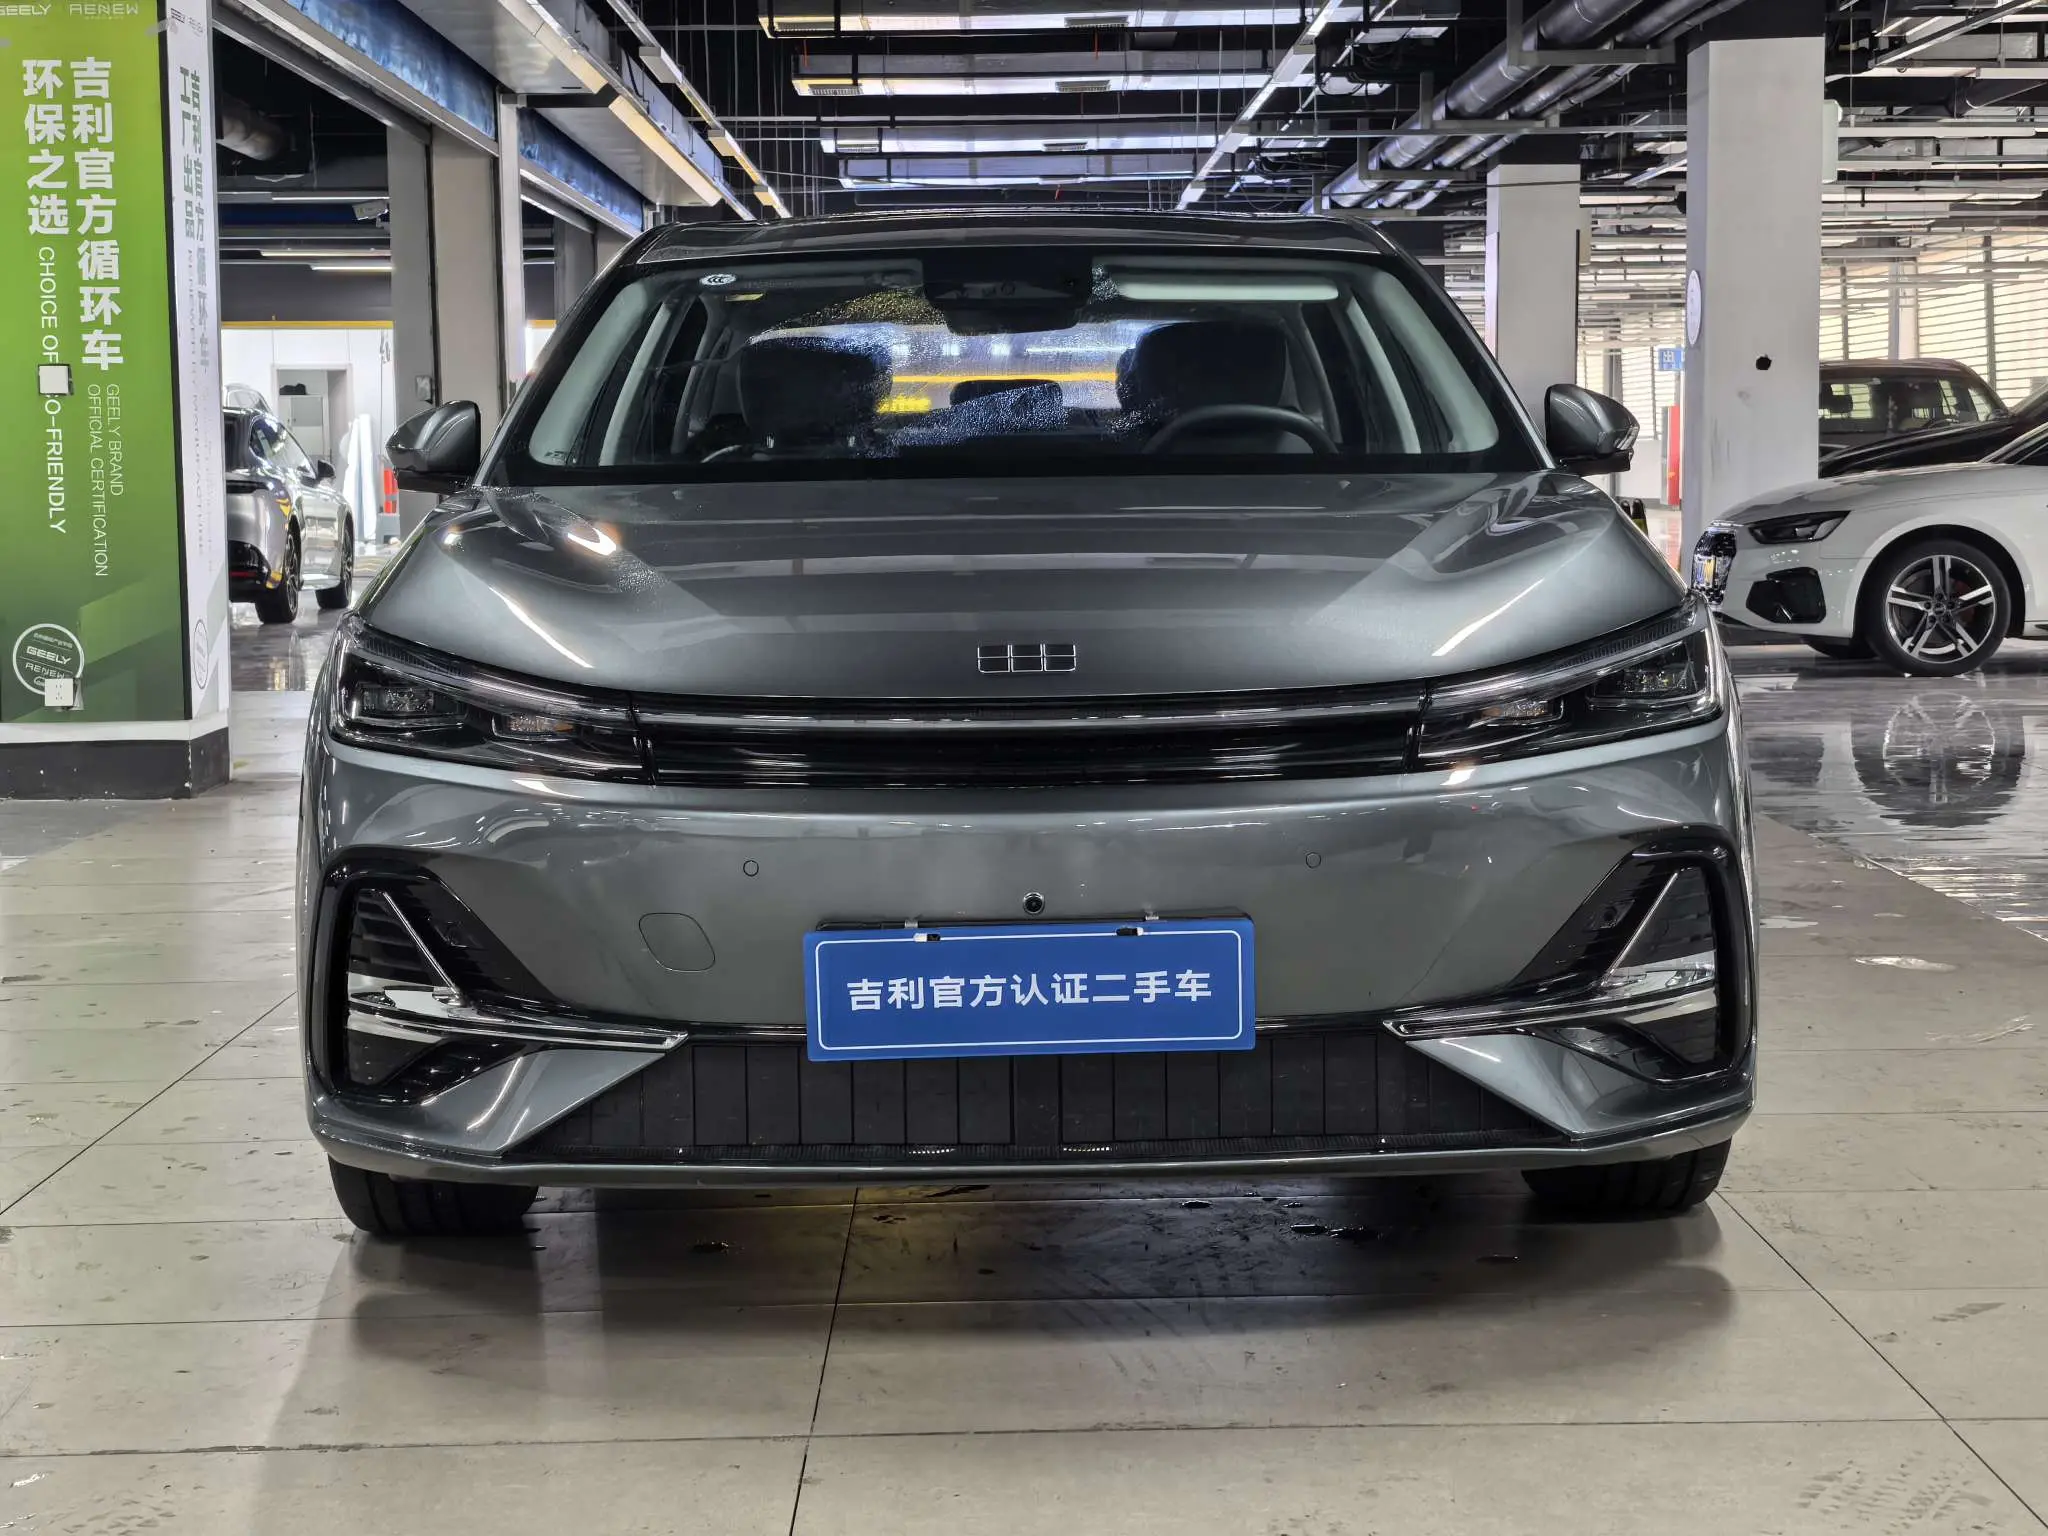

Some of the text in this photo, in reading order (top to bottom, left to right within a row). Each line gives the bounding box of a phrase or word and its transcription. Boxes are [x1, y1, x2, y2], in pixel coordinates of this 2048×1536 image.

[69, 4, 139, 16] RENEW
[22, 59, 70, 235] 环保之选
[70, 57, 124, 371] 吉利官方循环车
[38, 246, 67, 534] CHOICE OF O-FRIENDLY
[106, 384, 124, 496] GEELY BRAND
[87, 384, 109, 576] OFFICIAL CERTIFICATION
[26, 645, 72, 665] GEELY
[846, 968, 1212, 1012] 吉利官方认证二手车
